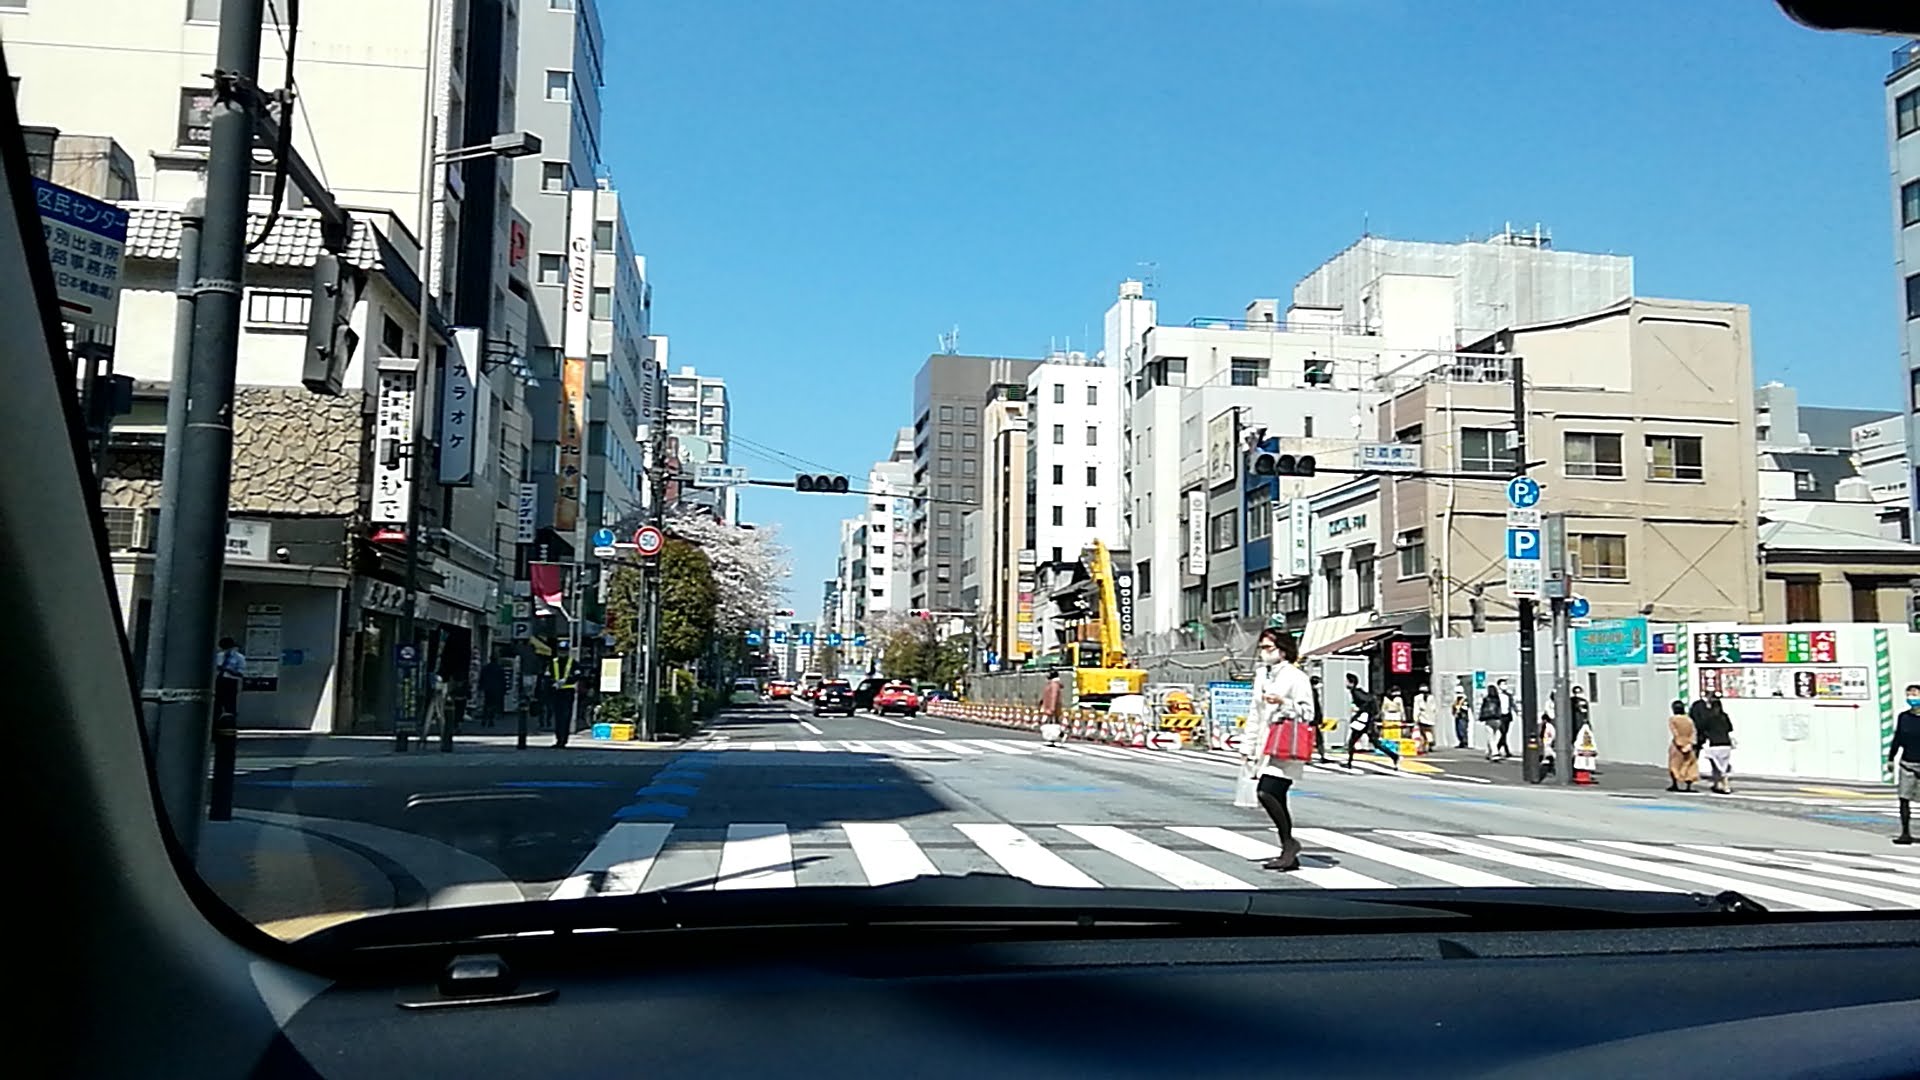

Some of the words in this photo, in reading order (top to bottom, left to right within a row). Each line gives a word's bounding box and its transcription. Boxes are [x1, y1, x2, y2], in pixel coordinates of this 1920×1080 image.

[36, 186, 125, 230] 区民センター
[572, 256, 586, 313] FUJIBO
[448, 363, 468, 449] カラオケ
[1514, 482, 1529, 504] P
[641, 533, 657, 547] 50
[1515, 531, 1536, 557] P
[515, 623, 528, 637] P
